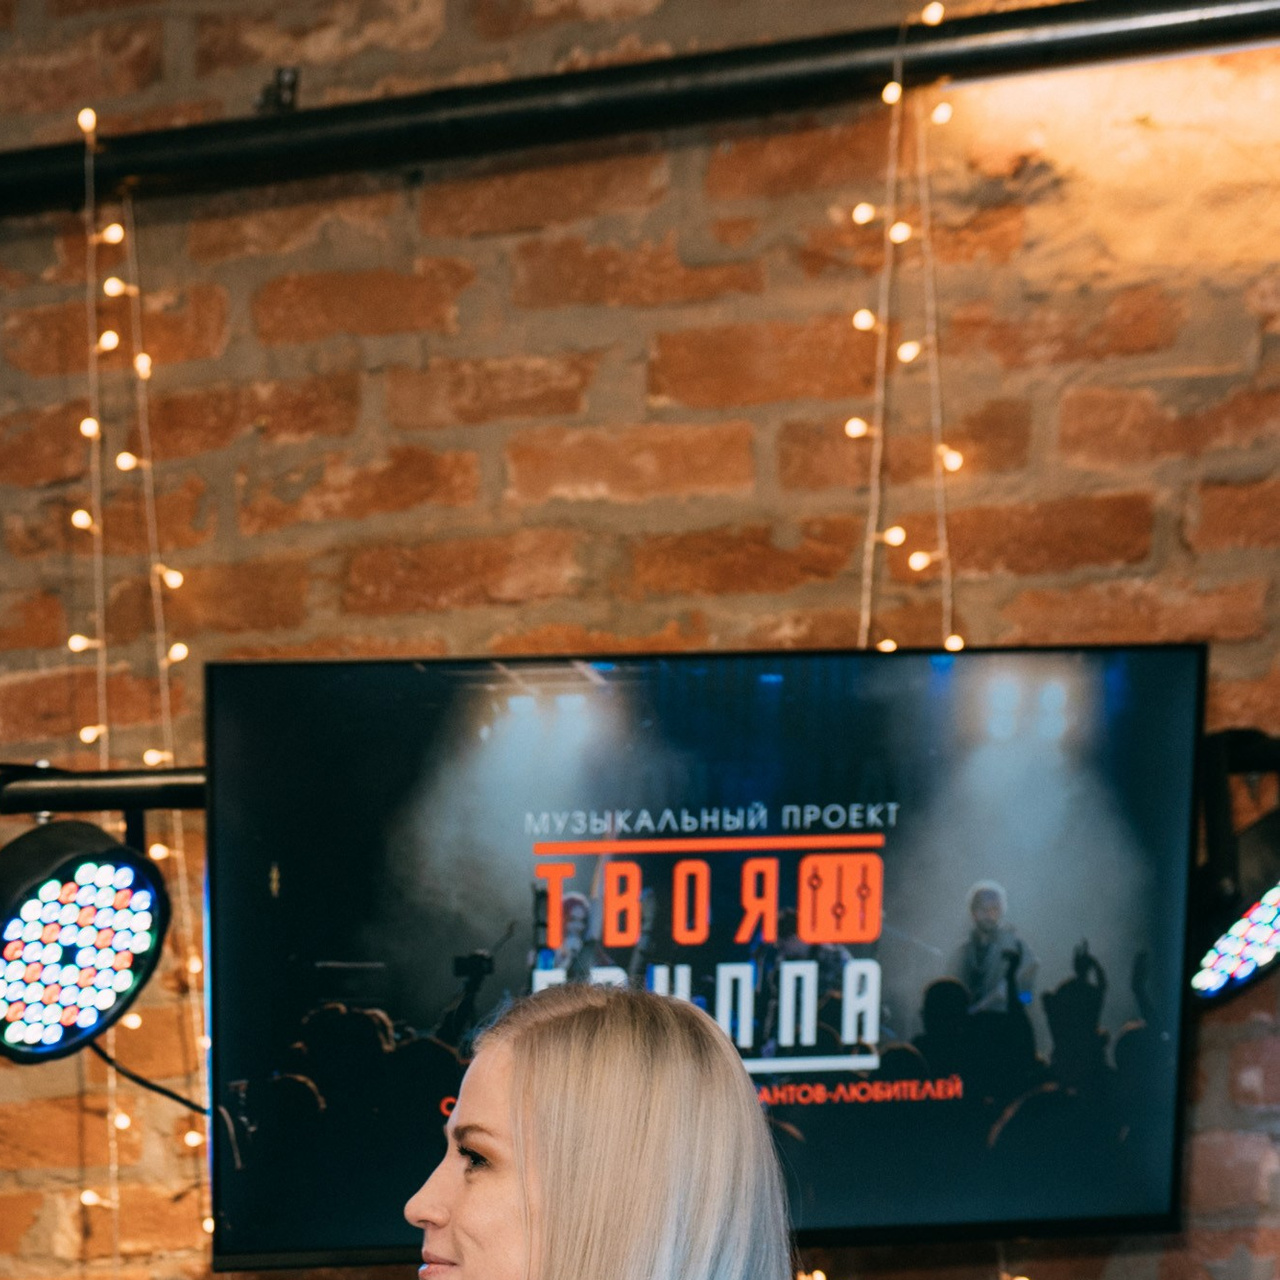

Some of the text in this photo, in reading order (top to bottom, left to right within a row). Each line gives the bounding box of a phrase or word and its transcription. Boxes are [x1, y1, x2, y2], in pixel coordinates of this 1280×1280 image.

[524, 801, 901, 835] МУЗЫКАЛЬНЫЙ ПРОЕКТ
[535, 857, 780, 950] ТВОЯ
[532, 959, 882, 1048] ППА
[758, 1073, 963, 1106] АНТОВ-ЛЮБИТЕЛЕЙ
